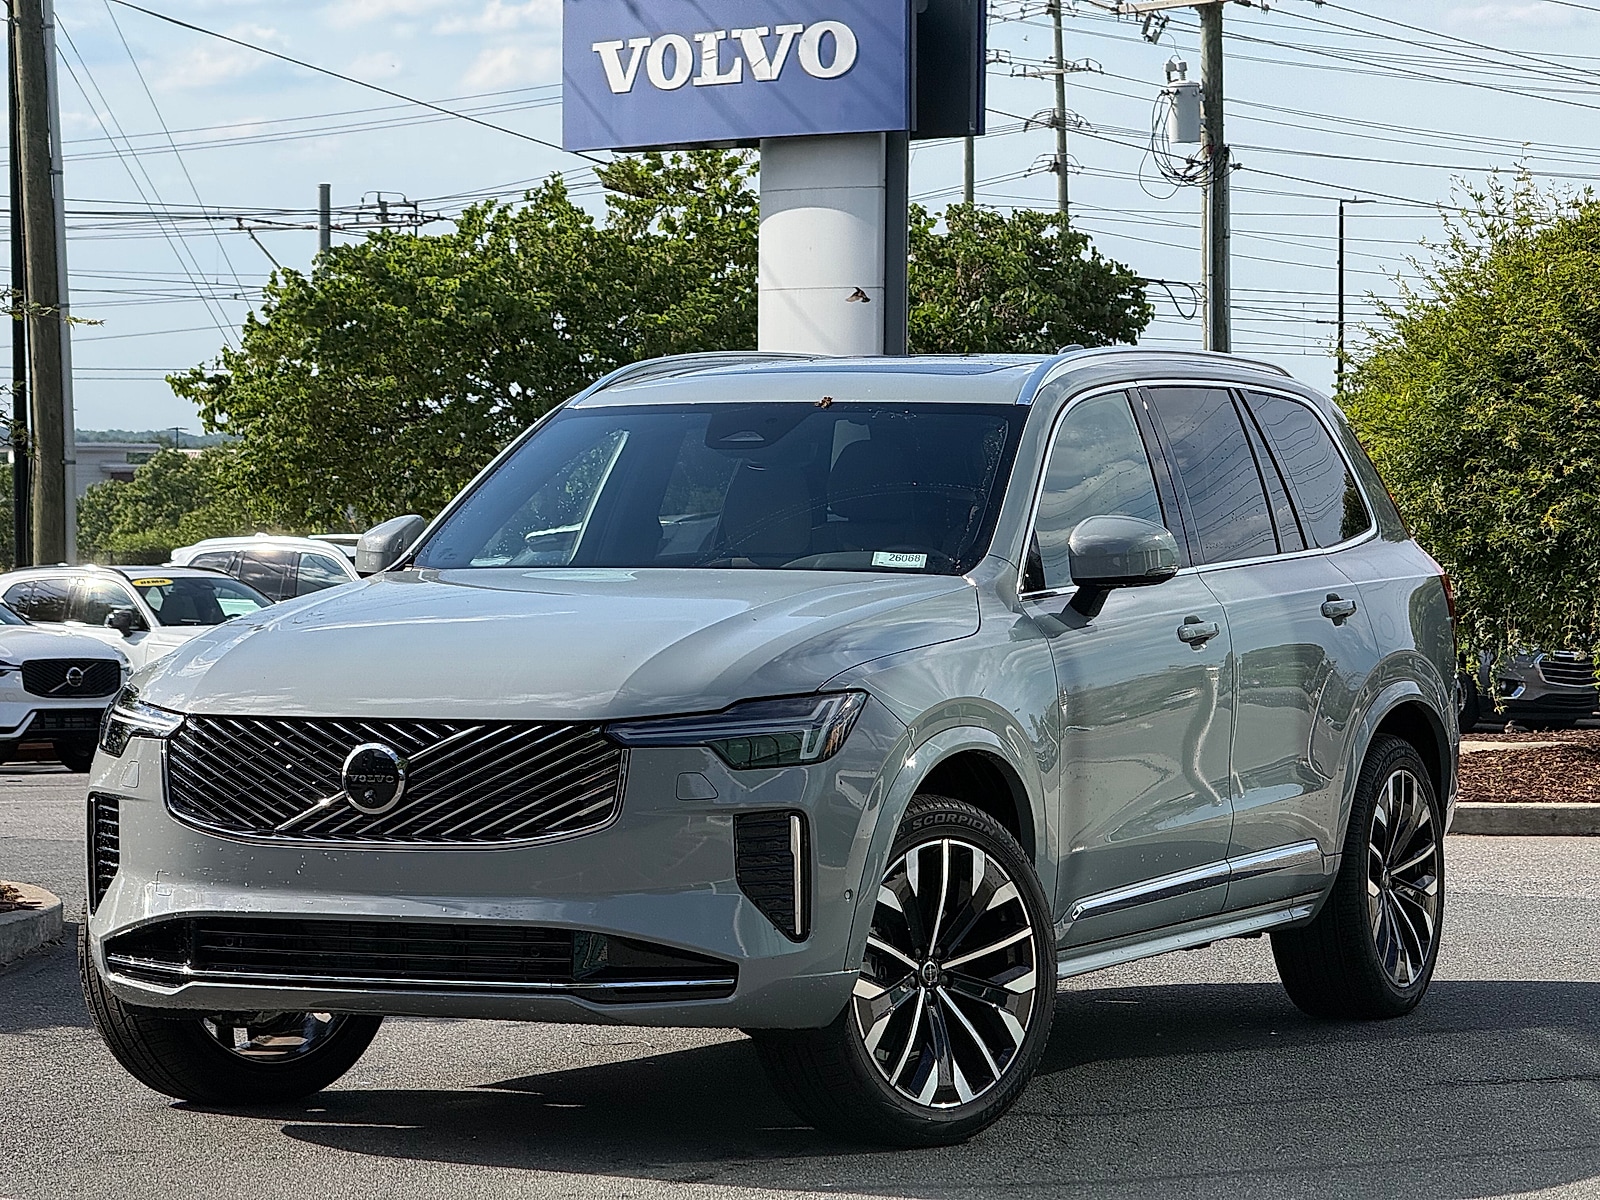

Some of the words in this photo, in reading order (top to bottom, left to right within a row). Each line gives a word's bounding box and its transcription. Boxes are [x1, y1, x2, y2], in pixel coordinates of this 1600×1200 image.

[592, 20, 857, 93] VOLVO
[889, 553, 921, 562] 26068
[348, 774, 395, 783] VOLVO
[912, 813, 995, 836] SCORPION
